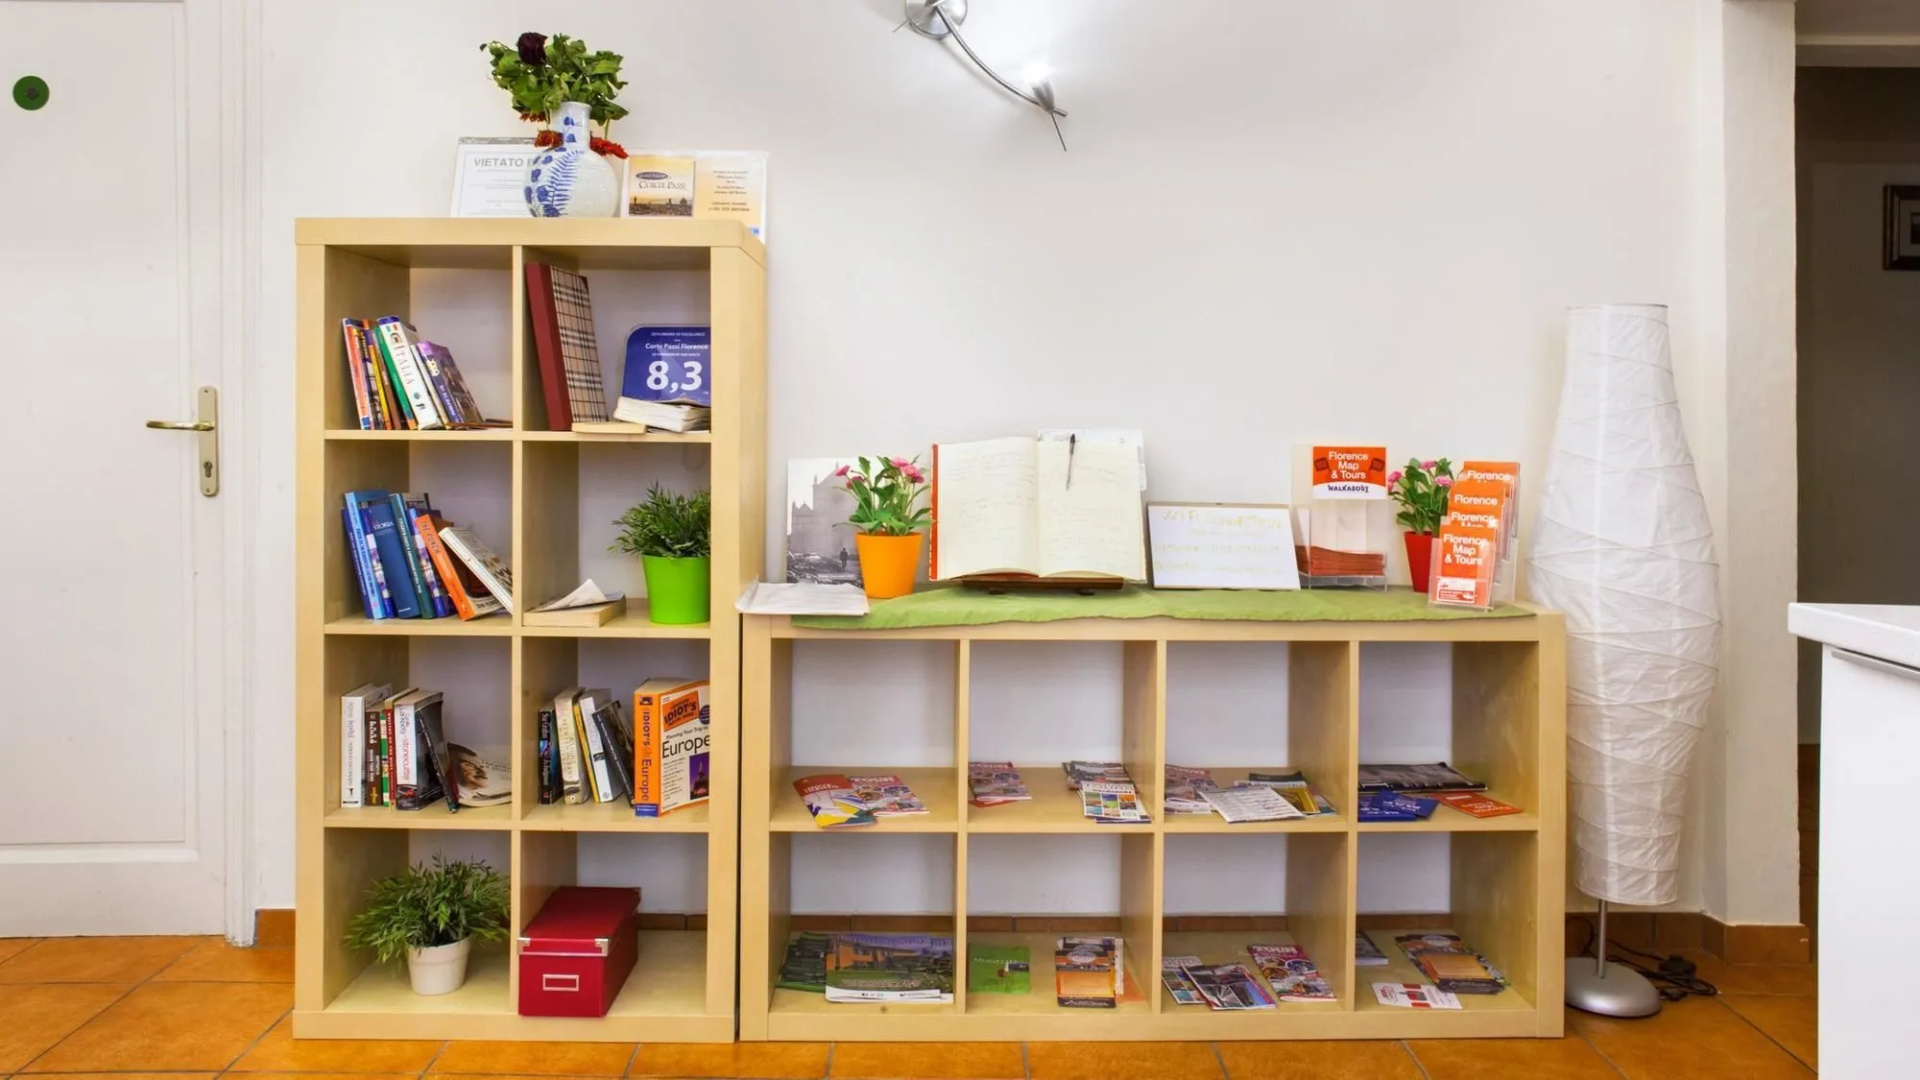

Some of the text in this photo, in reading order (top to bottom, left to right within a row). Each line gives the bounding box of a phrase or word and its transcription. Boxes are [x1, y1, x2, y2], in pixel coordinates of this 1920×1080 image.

[474, 157, 524, 168] VIETATO
[664, 342, 680, 350] Passi
[646, 360, 702, 393] 8,3
[1328, 451, 1369, 462] Florence
[1338, 461, 1359, 471] Map
[1331, 470, 1367, 479] & Tours
[1467, 470, 1512, 481] Florence
[1454, 494, 1498, 505] Florence
[1451, 511, 1495, 523] Florence
[1443, 533, 1490, 547] Florence
[1453, 544, 1476, 556] Map
[1444, 554, 1484, 566] & Tours
[664, 701, 697, 724] IDIOT'S
[642, 711, 650, 747] IDIOT'S
[662, 734, 710, 759] Europe
[638, 758, 652, 802] Europe
